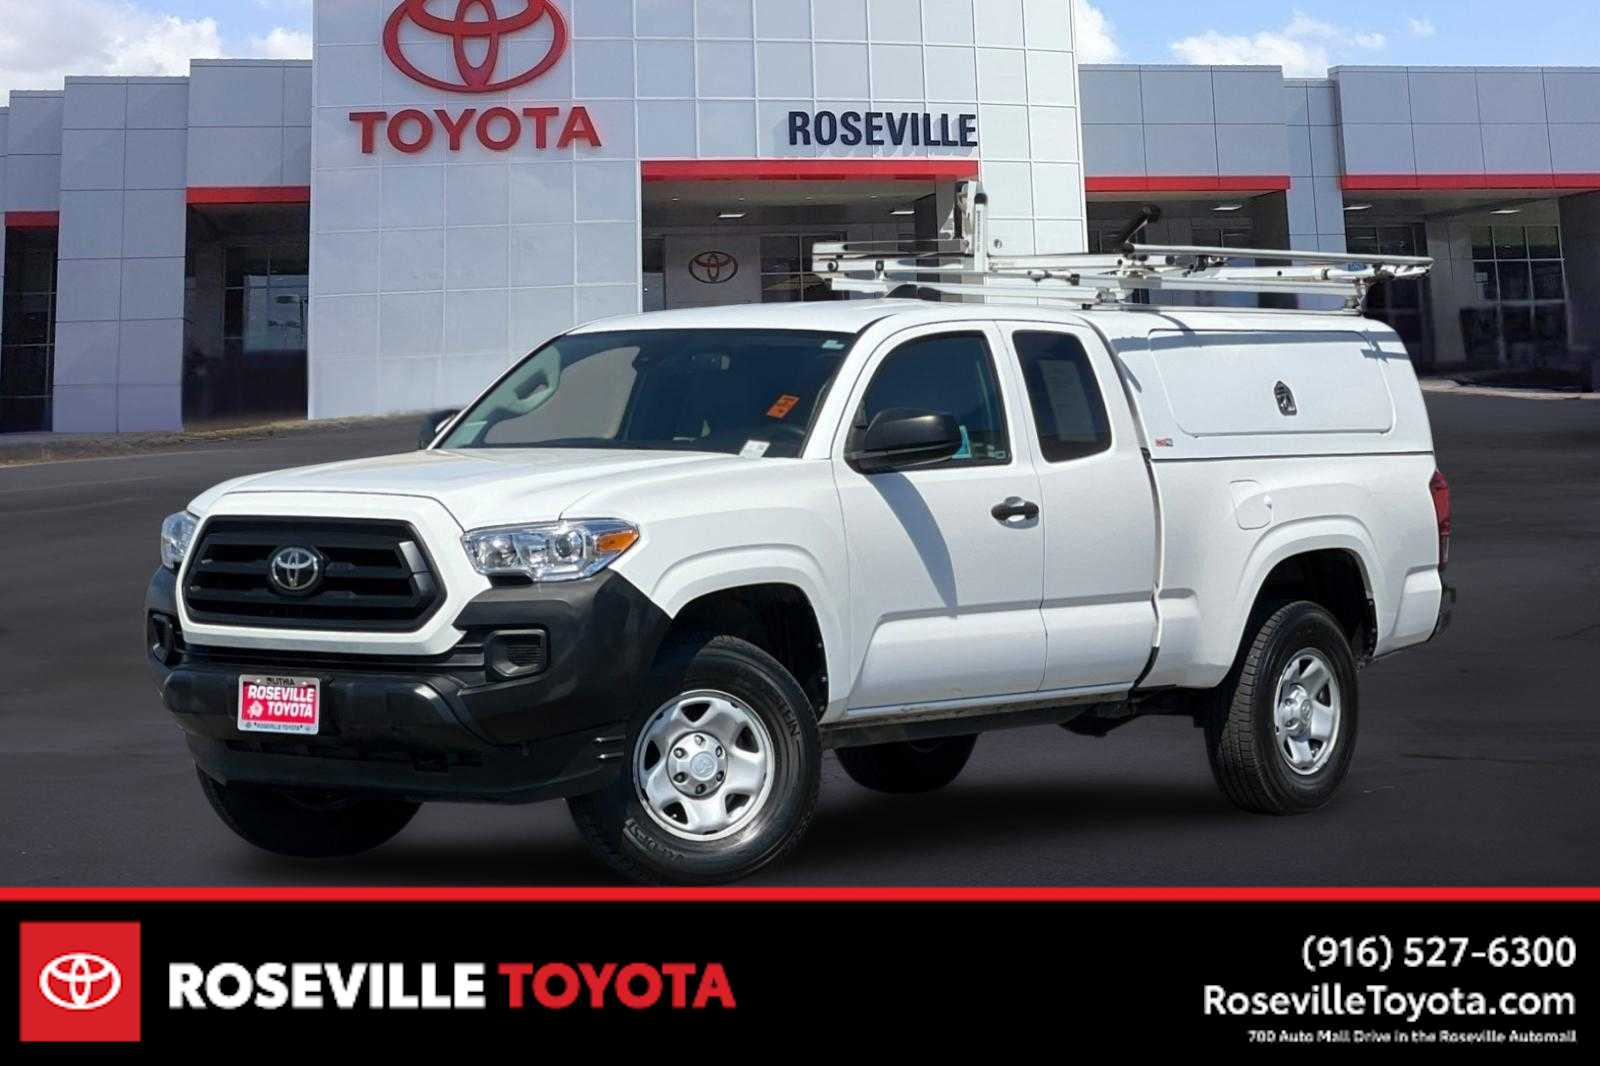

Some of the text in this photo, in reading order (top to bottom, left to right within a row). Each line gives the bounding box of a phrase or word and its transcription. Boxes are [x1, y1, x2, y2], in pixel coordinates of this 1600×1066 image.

[349, 106, 602, 154] TOYOTA
[788, 111, 978, 147] ROSEVILLE
[248, 685, 315, 702] ROSEVILLE
[267, 701, 313, 718] TOYOTA
